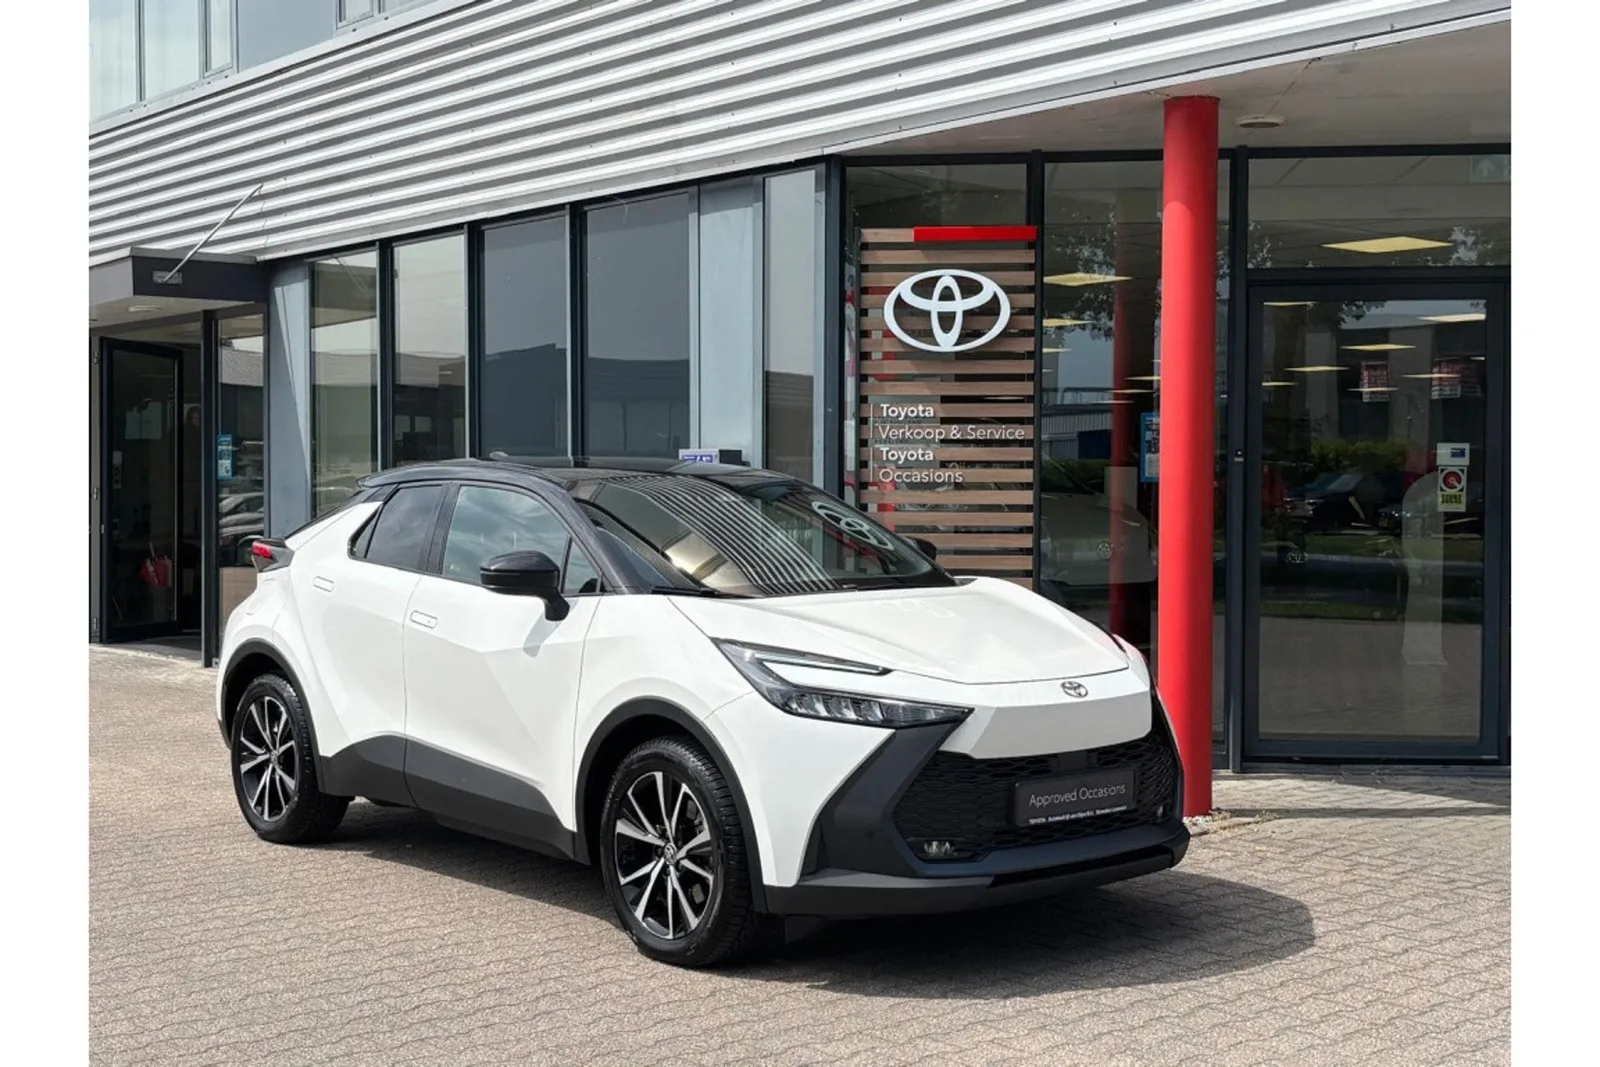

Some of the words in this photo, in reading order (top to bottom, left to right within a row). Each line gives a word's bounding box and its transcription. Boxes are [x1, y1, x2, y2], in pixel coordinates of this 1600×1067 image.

[880, 403, 934, 420] Toyota
[878, 425, 945, 442] Verkoop
[950, 425, 962, 440] &
[966, 424, 1025, 440] Service
[880, 447, 934, 464] Toyota
[879, 468, 964, 483] Occasions
[1029, 789, 1077, 808] Approved
[1079, 784, 1126, 800] Occasions
